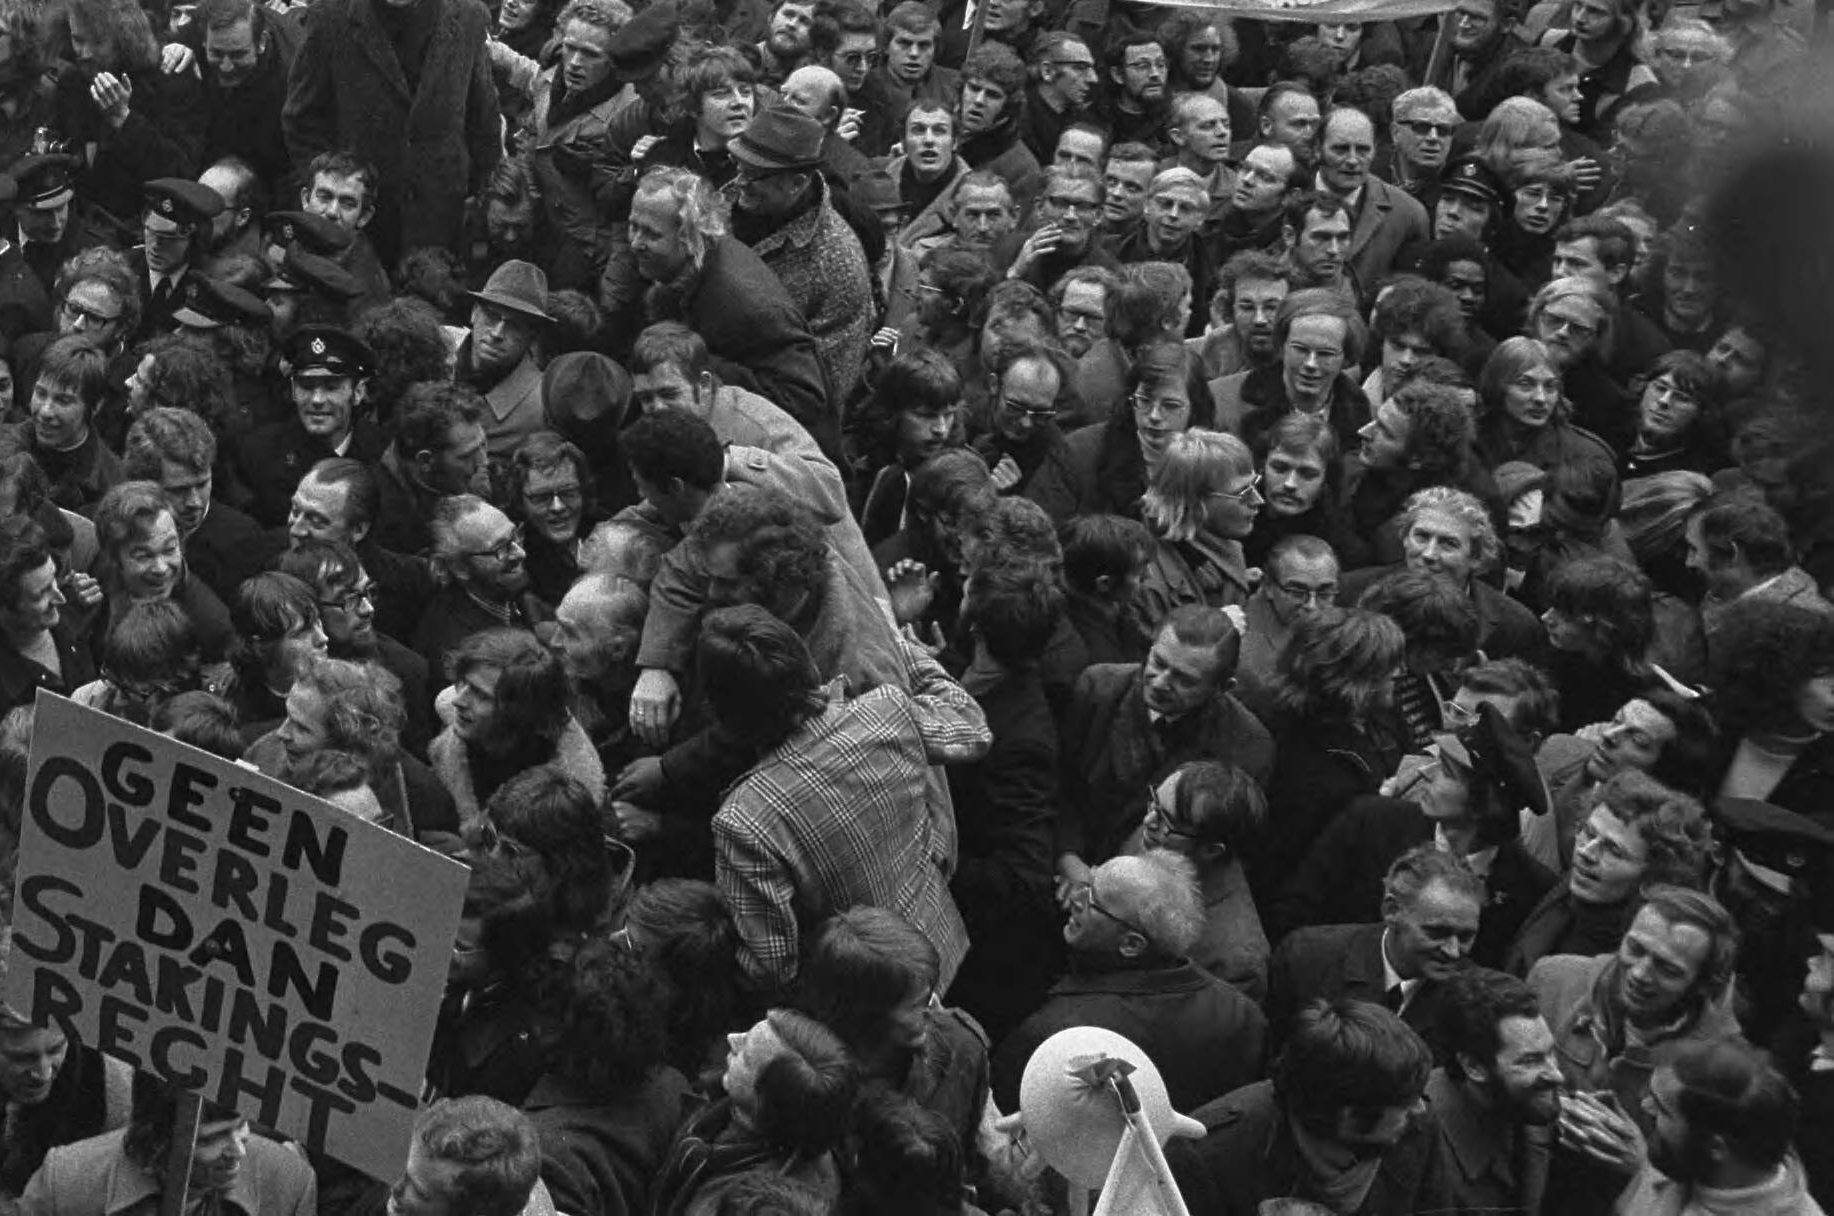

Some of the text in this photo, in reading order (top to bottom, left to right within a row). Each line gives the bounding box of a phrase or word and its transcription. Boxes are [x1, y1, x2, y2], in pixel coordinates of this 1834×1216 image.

[28, 755, 417, 985] OVERLEG
[101, 741, 349, 887] GEEN
[11, 874, 419, 1110] STAKINGS-
[135, 882, 340, 1022] DAN
[30, 966, 357, 1156] RECHT
